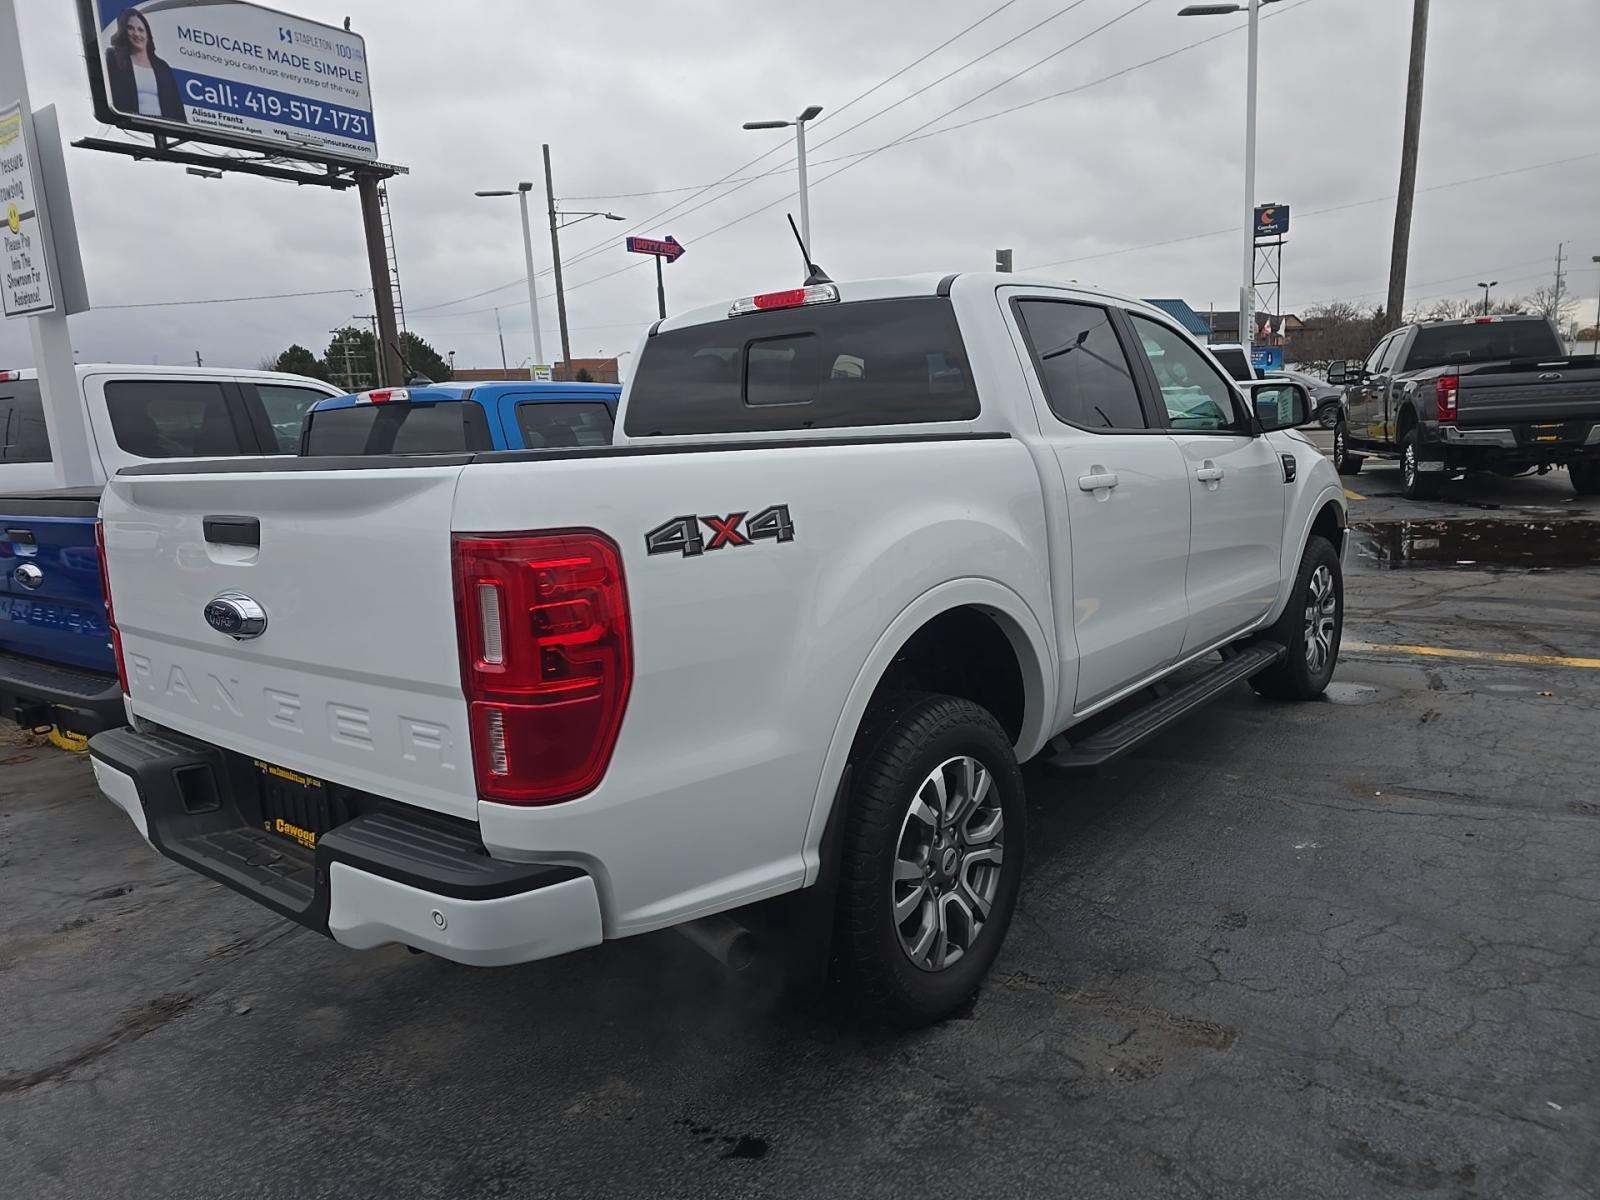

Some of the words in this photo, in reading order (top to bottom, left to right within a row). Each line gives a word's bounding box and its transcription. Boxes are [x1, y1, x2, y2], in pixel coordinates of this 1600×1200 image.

[177, 25, 264, 60] MEDICARE
[267, 48, 310, 71] MADE
[314, 60, 363, 84] SIMPLE
[180, 46, 222, 63] Guidance
[222, 59, 240, 68] you
[242, 61, 258, 71] can
[258, 65, 279, 77] trust
[280, 72, 302, 83] every
[303, 77, 320, 87] step
[322, 80, 329, 88] of
[330, 81, 344, 92] the
[185, 79, 239, 108] Call:
[244, 91, 369, 136] 419-517-1731
[192, 108, 217, 119] Alissa
[217, 112, 244, 124] Frantz
[192, 116, 218, 126] Licensed
[218, 121, 245, 131] Insurance
[246, 126, 263, 135] Agent
[129, 651, 456, 770] RANGER
[276, 818, 316, 845] Cawood
